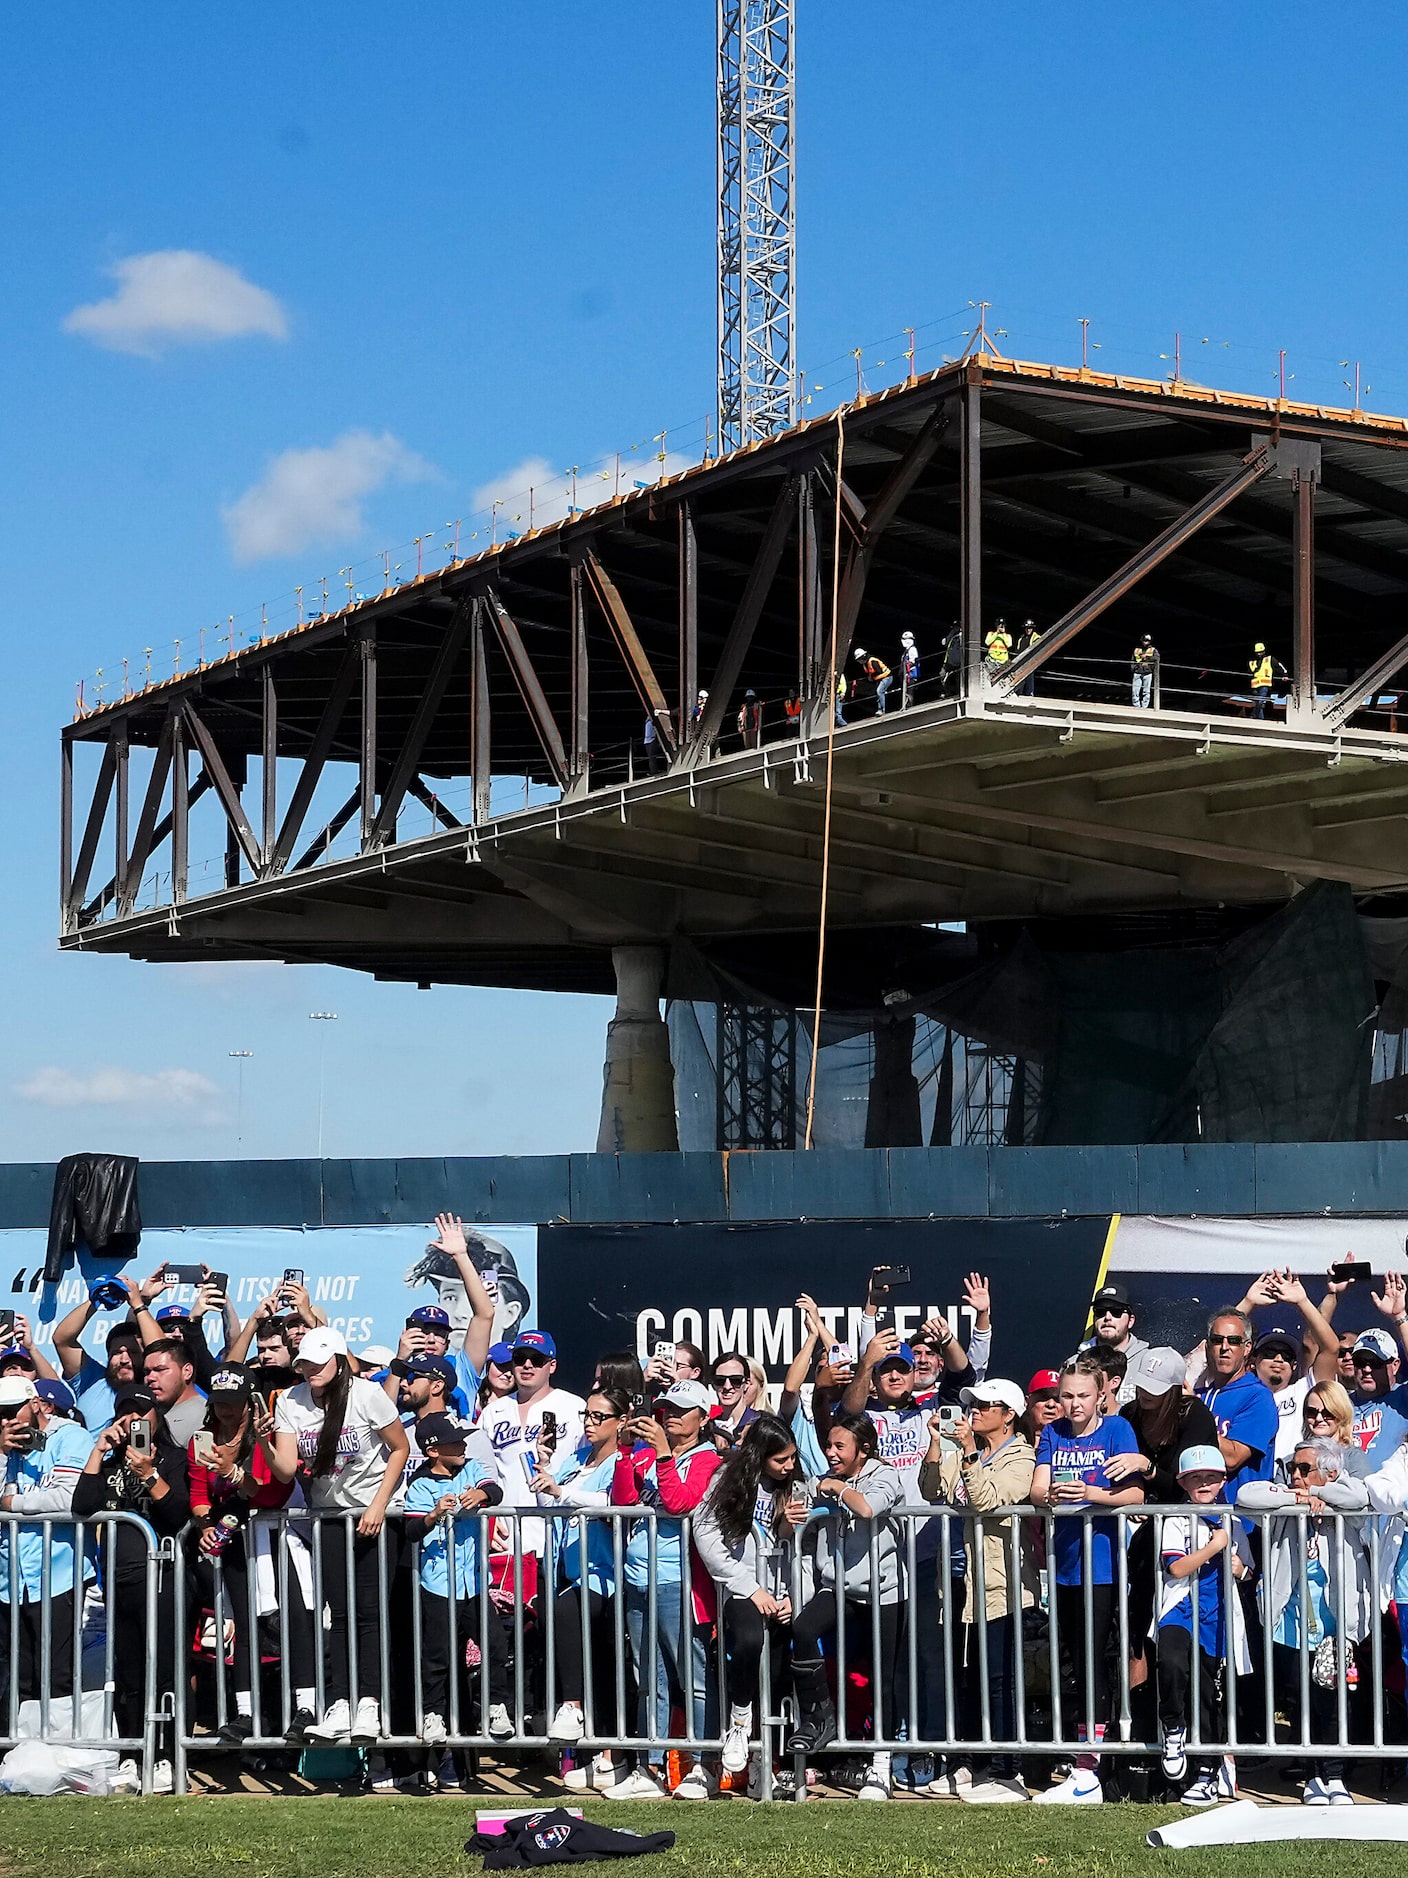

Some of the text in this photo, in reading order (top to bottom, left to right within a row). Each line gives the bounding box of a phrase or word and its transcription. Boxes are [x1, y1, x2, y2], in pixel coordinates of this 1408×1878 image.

[314, 1275, 360, 1302] NOT
[1146, 1358, 1162, 1373] T
[1047, 1371, 1060, 1382] T
[1190, 1449, 1206, 1464] T
